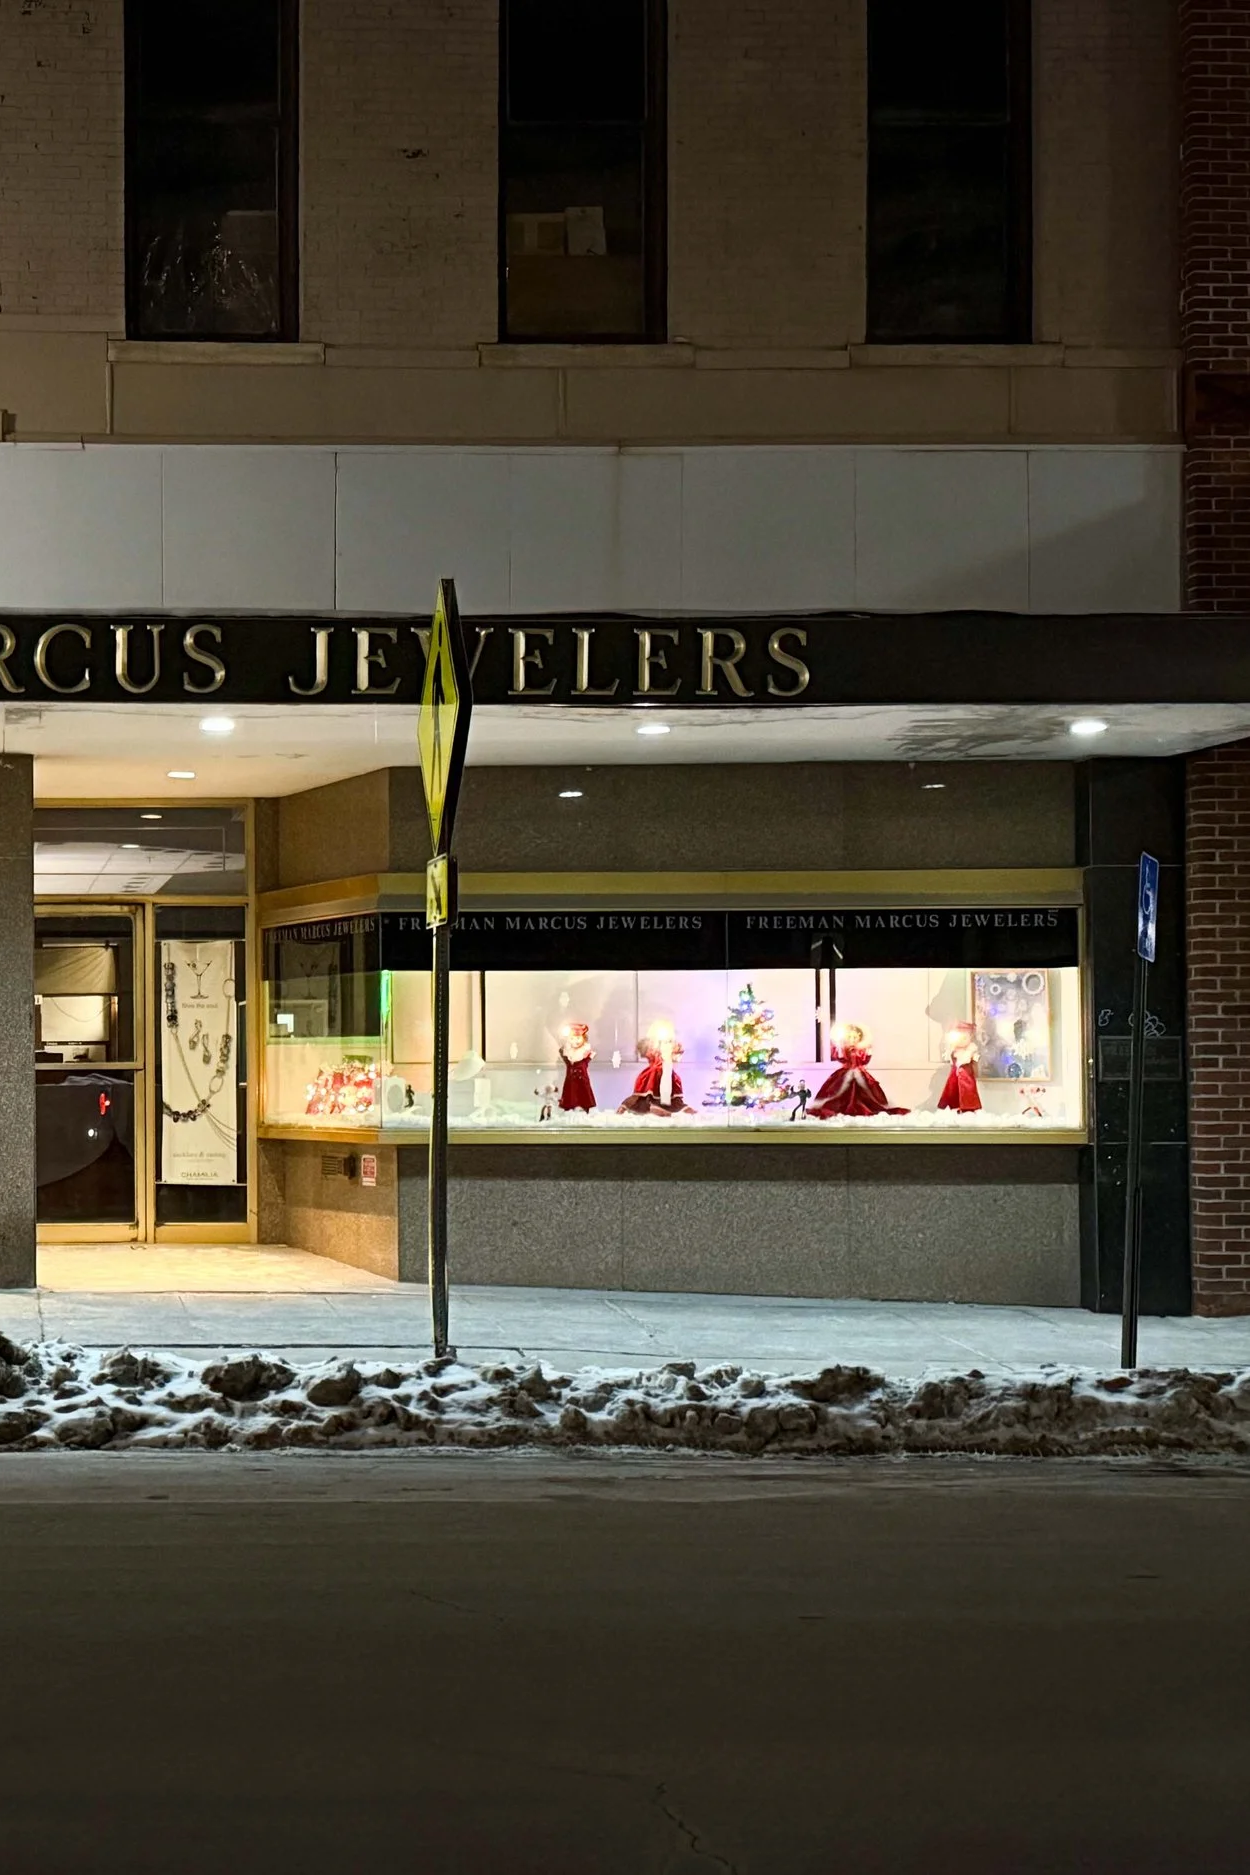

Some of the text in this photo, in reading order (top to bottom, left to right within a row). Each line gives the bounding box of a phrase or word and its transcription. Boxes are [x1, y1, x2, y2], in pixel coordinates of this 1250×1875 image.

[398, 915, 703, 930] FRMAN MARCUS JEWELERS
[745, 912, 1059, 929] FREEMAN MARCUS JEWELERS
